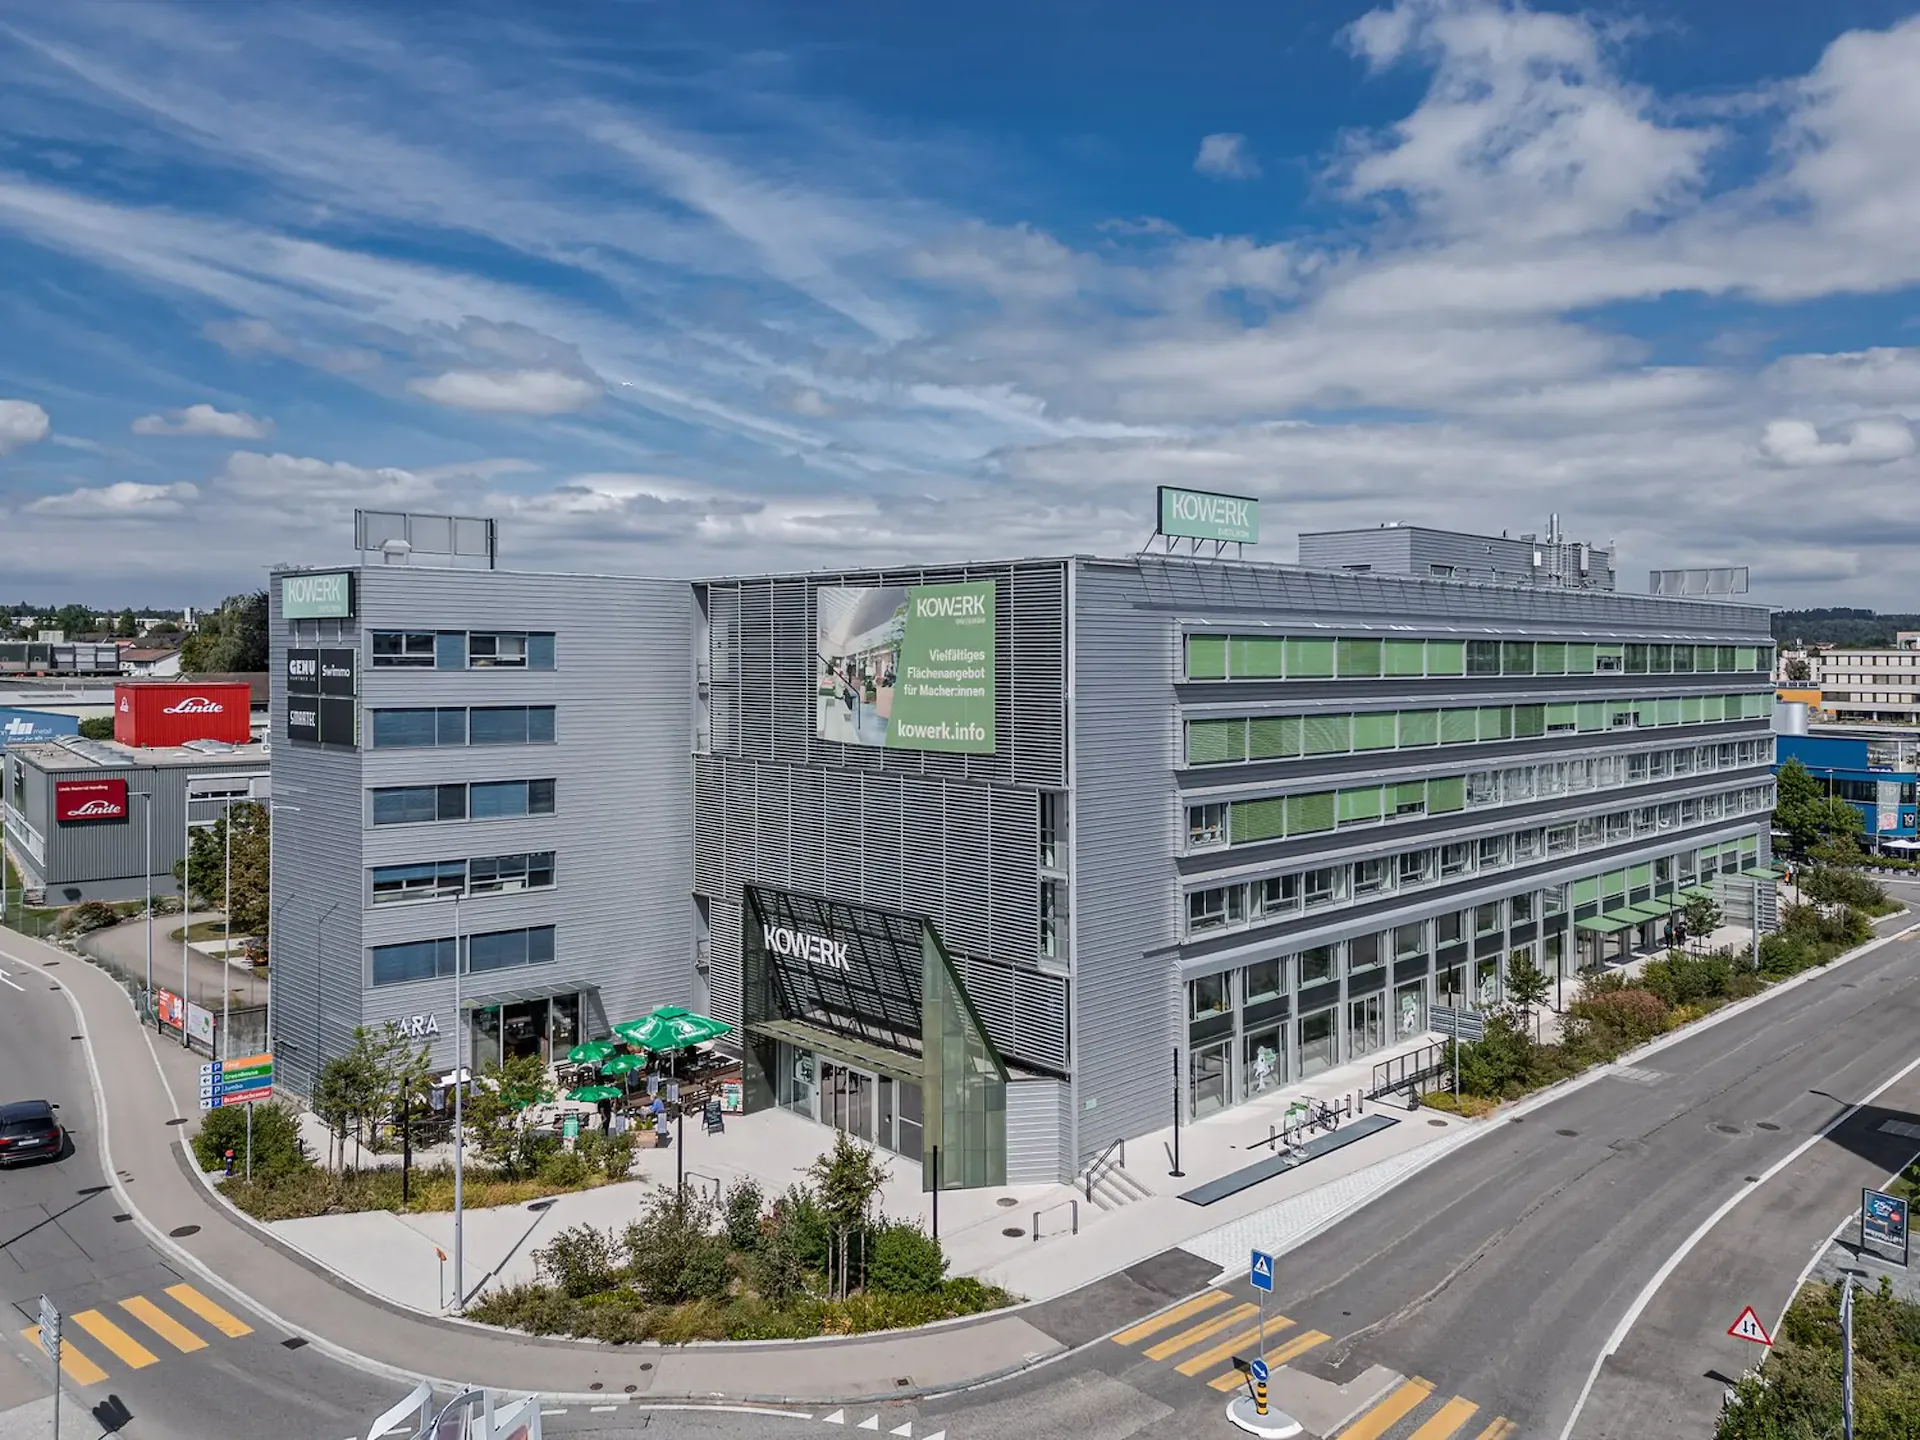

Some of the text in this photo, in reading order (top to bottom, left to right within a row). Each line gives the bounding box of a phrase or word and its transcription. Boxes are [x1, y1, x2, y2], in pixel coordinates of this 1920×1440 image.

[1172, 493, 1249, 527] KOWERK
[288, 577, 341, 603] KOWERK
[916, 594, 985, 617] KOWERK
[929, 649, 985, 663] Vielfältiges
[322, 664, 351, 677] Swimmo
[907, 666, 985, 681] Flächenangebot
[903, 684, 985, 697] für Macher:innen
[163, 697, 223, 714] Linde
[897, 719, 985, 741] kowerk.info
[67, 800, 121, 816] Linde
[763, 924, 851, 971] KOWERK
[214, 1063, 220, 1071] P
[214, 1070, 259, 1083] P Greenhouse
[215, 1083, 243, 1095] P Jumbo
[223, 1089, 271, 1104] Brandbachcenter
